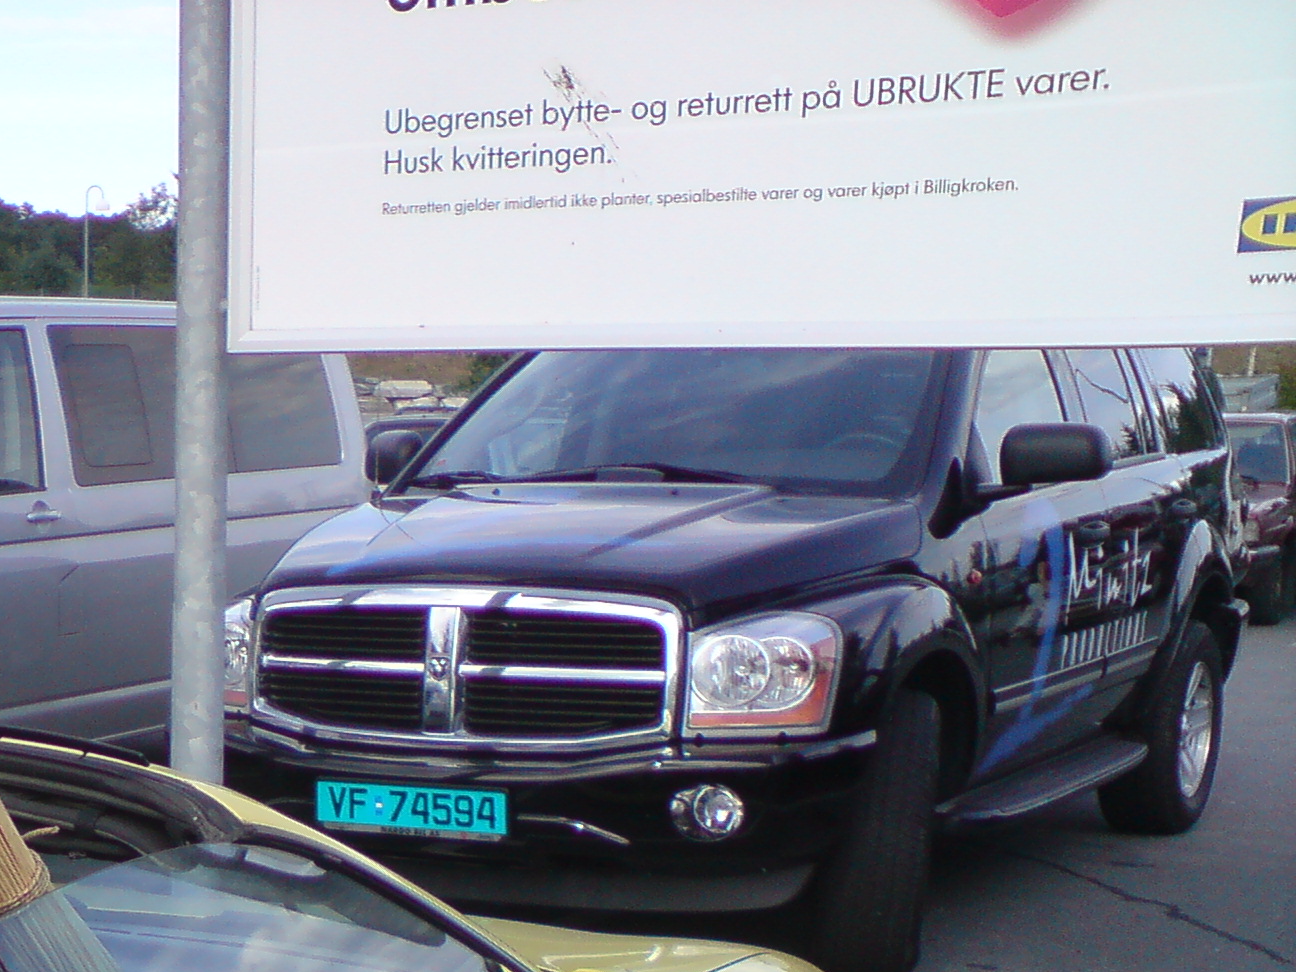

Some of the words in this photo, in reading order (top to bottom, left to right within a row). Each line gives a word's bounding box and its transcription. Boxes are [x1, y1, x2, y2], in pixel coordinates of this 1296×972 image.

[385, 103, 533, 138] Ubegrenset
[542, 98, 622, 131] bytte-
[631, 100, 667, 126] og
[677, 87, 793, 117] returrett
[801, 80, 841, 118] på
[853, 68, 1005, 107] UBRUKTE
[1015, 68, 1109, 96] varer.
[384, 147, 443, 174] Husk
[453, 142, 612, 173] kvitteringen.
[382, 201, 451, 215] Returretten
[454, 197, 501, 216] gjelder
[504, 194, 567, 211] imidlertid
[571, 193, 597, 208] ikke
[601, 192, 653, 209] planter,
[656, 186, 757, 206] spesialbestilte
[761, 188, 799, 200] varer
[803, 187, 822, 201] og
[828, 185, 866, 199] varer
[872, 181, 910, 199] kjøpt
[924, 177, 1019, 196] Billigkroken.
[328, 786, 368, 819] VF
[389, 790, 497, 830] 74594
